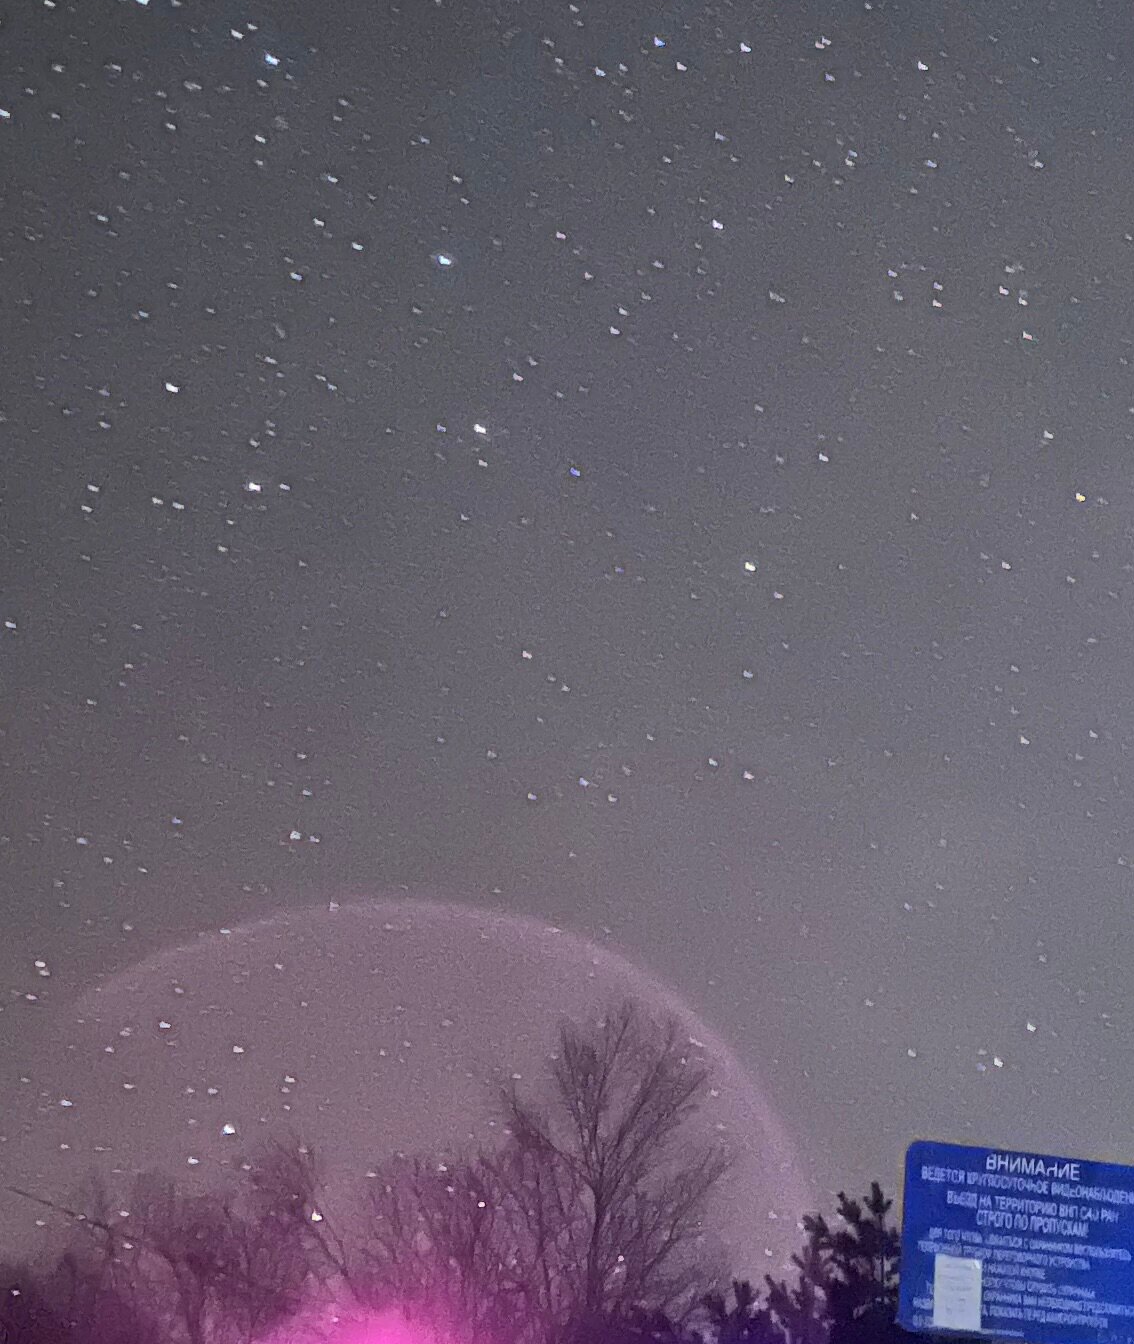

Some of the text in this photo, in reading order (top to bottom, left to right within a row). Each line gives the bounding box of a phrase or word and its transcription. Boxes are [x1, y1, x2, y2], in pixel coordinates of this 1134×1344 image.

[921, 1165, 965, 1184] ВЕДЕТСЯ
[985, 1153, 1081, 1181] ВНИМАНИЕ
[978, 1194, 992, 1209] НА
[994, 1195, 1057, 1216] ТЕРРИТОРИЮ
[976, 1209, 1013, 1229] СТРОГО
[1014, 1213, 1029, 1230] ПО
